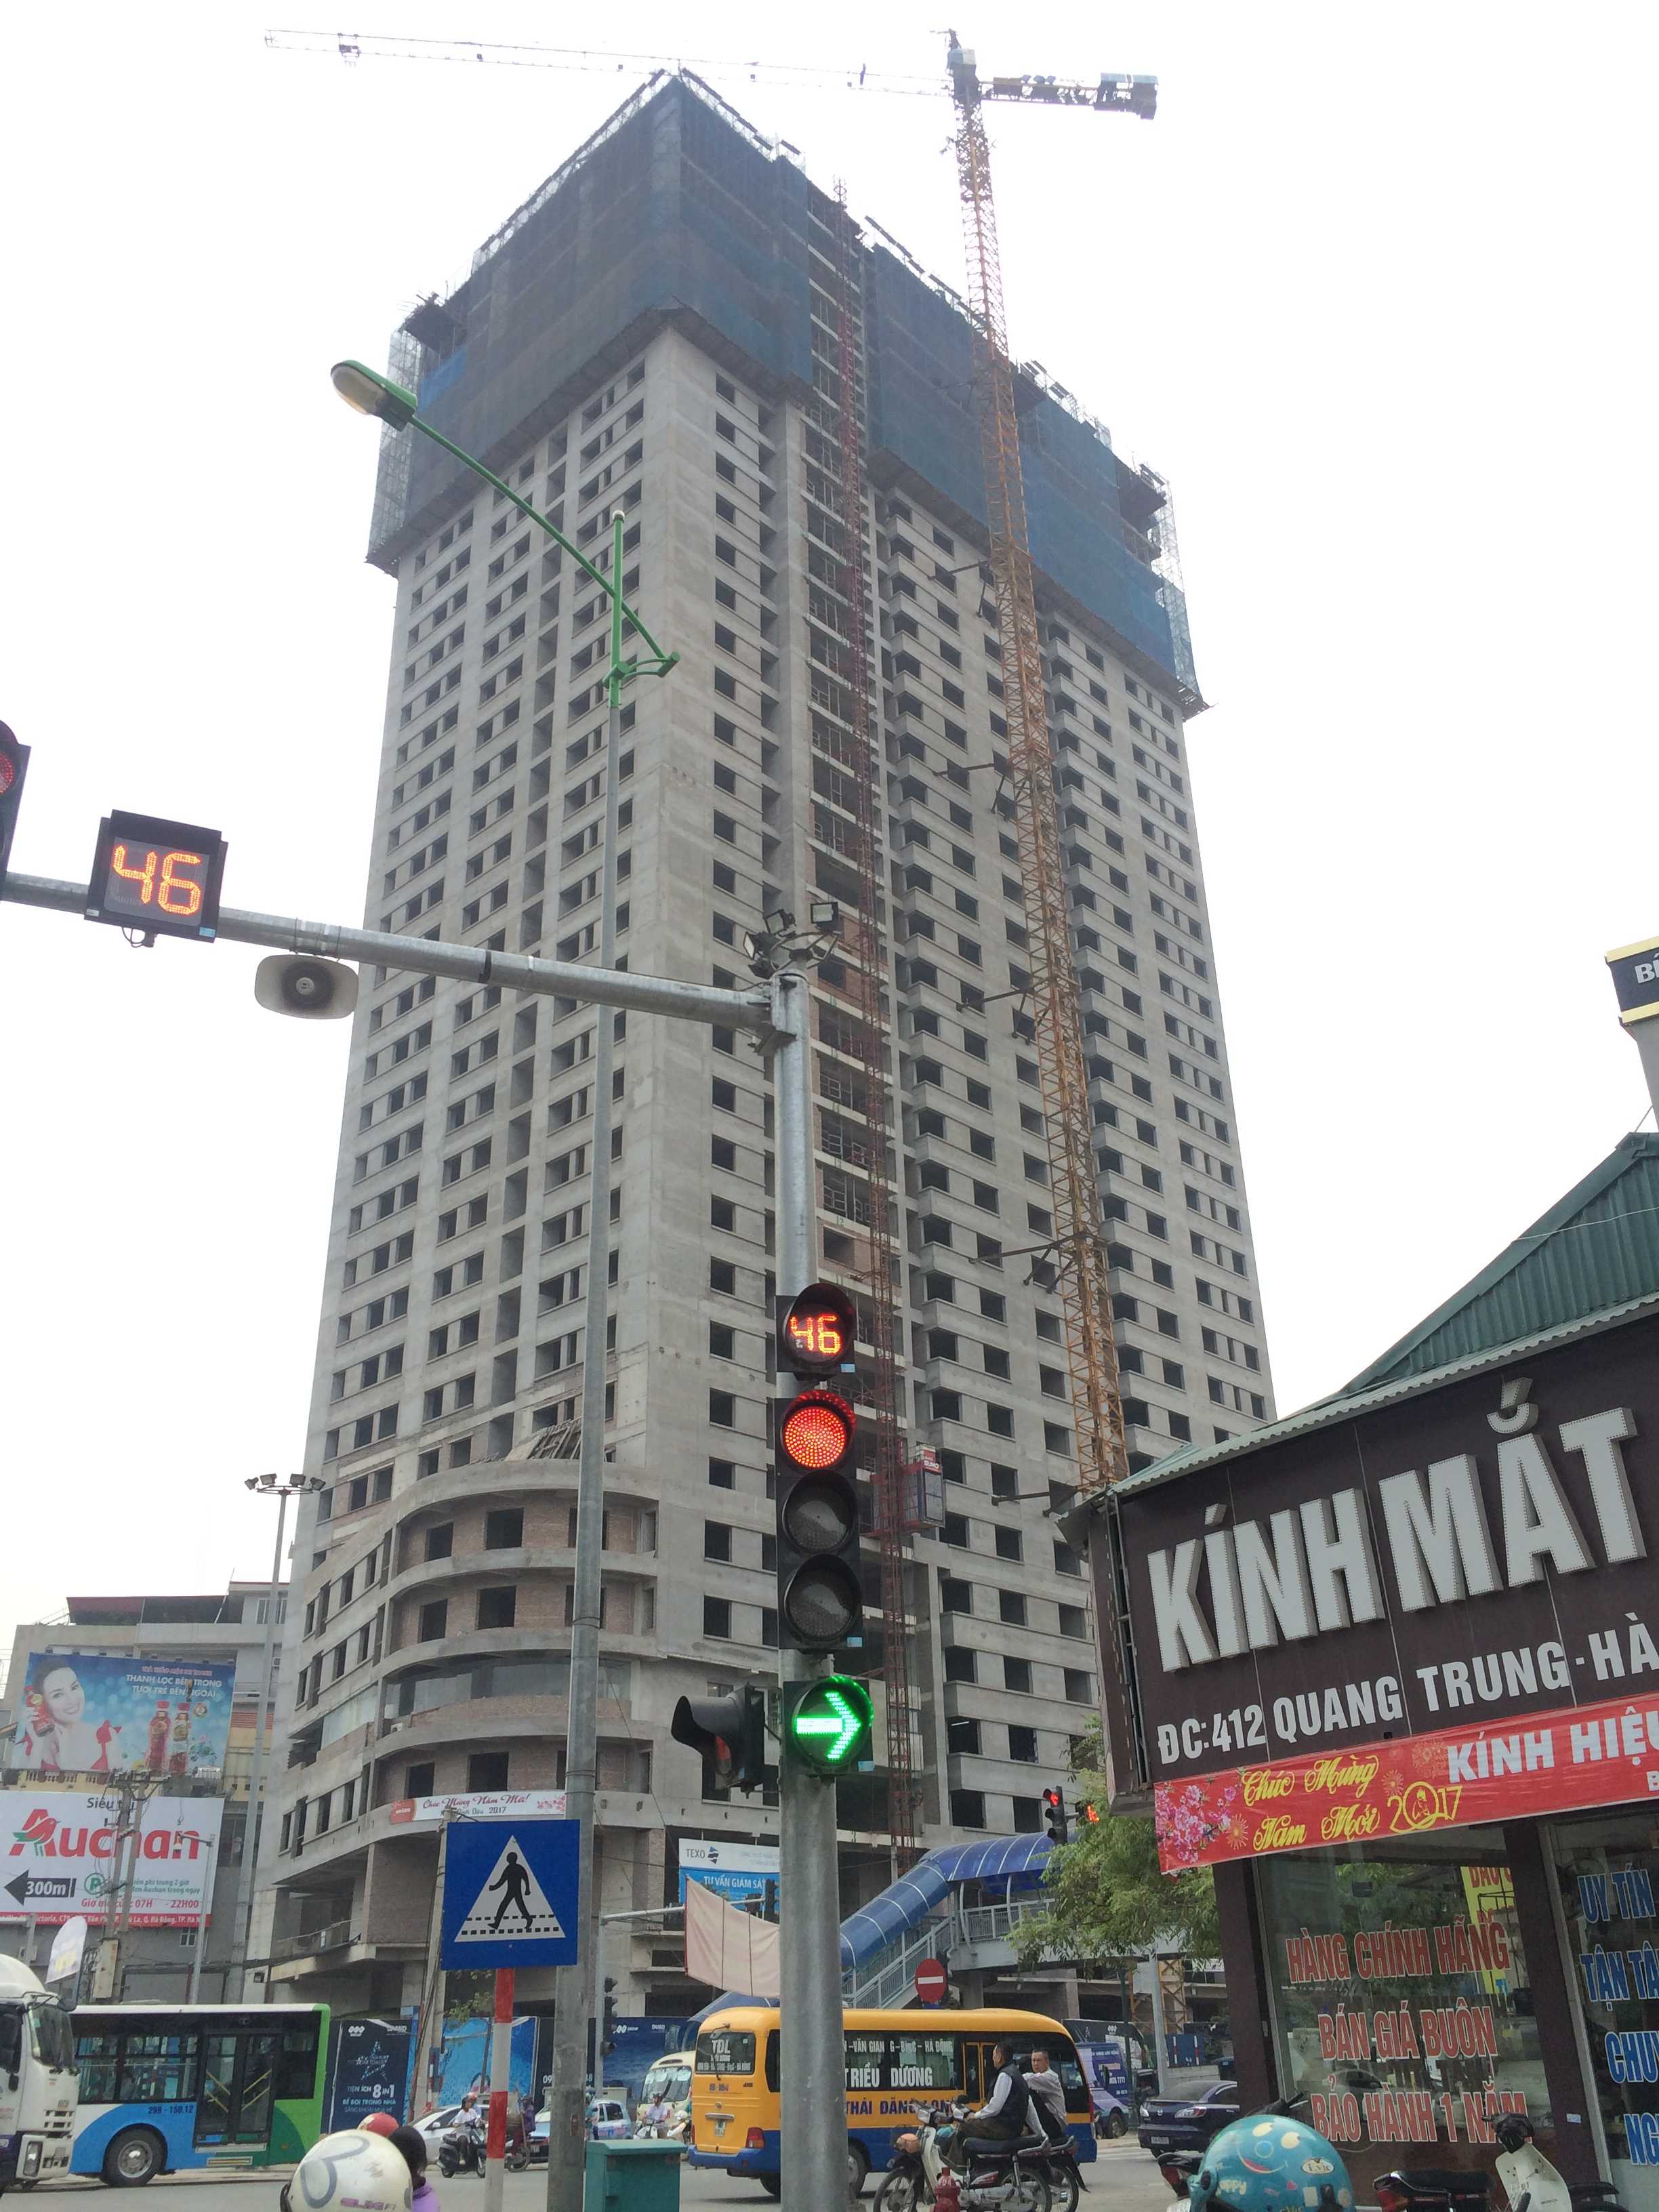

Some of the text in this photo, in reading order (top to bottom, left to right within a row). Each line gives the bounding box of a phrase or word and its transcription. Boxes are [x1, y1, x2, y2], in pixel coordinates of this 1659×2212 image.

[112, 845, 201, 915] 46
[790, 1315, 840, 1353] 46
[1147, 1377, 1647, 1673] KÍNH MẮT
[126, 1674, 156, 1683] THANH
[1273, 1676, 1404, 1743] QUANG
[1416, 1641, 1570, 1712] TRUNG
[1242, 1754, 1380, 1807] Chúc Mừng
[1447, 1731, 1555, 1784] KÍNH
[87, 1797, 114, 1809] Siêu
[686, 1849, 705, 1859] TEXO
[25, 1881, 67, 1896] 300m
[1577, 1863, 1657, 1923] UY TÍN
[1285, 1914, 1512, 1984] HÀNG CHÍNH HÃNG
[1578, 1940, 1659, 2011] TẬN TÂ
[1317, 1996, 1498, 2061] BÁN GIÁ BUÔN
[372, 2084, 382, 2099] 8
[1311, 2074, 1362, 2142] BẢO
[1363, 2081, 1438, 2142] HÀNH
[1439, 2092, 1459, 2143] 1
[1624, 2112, 1659, 2167] NG
